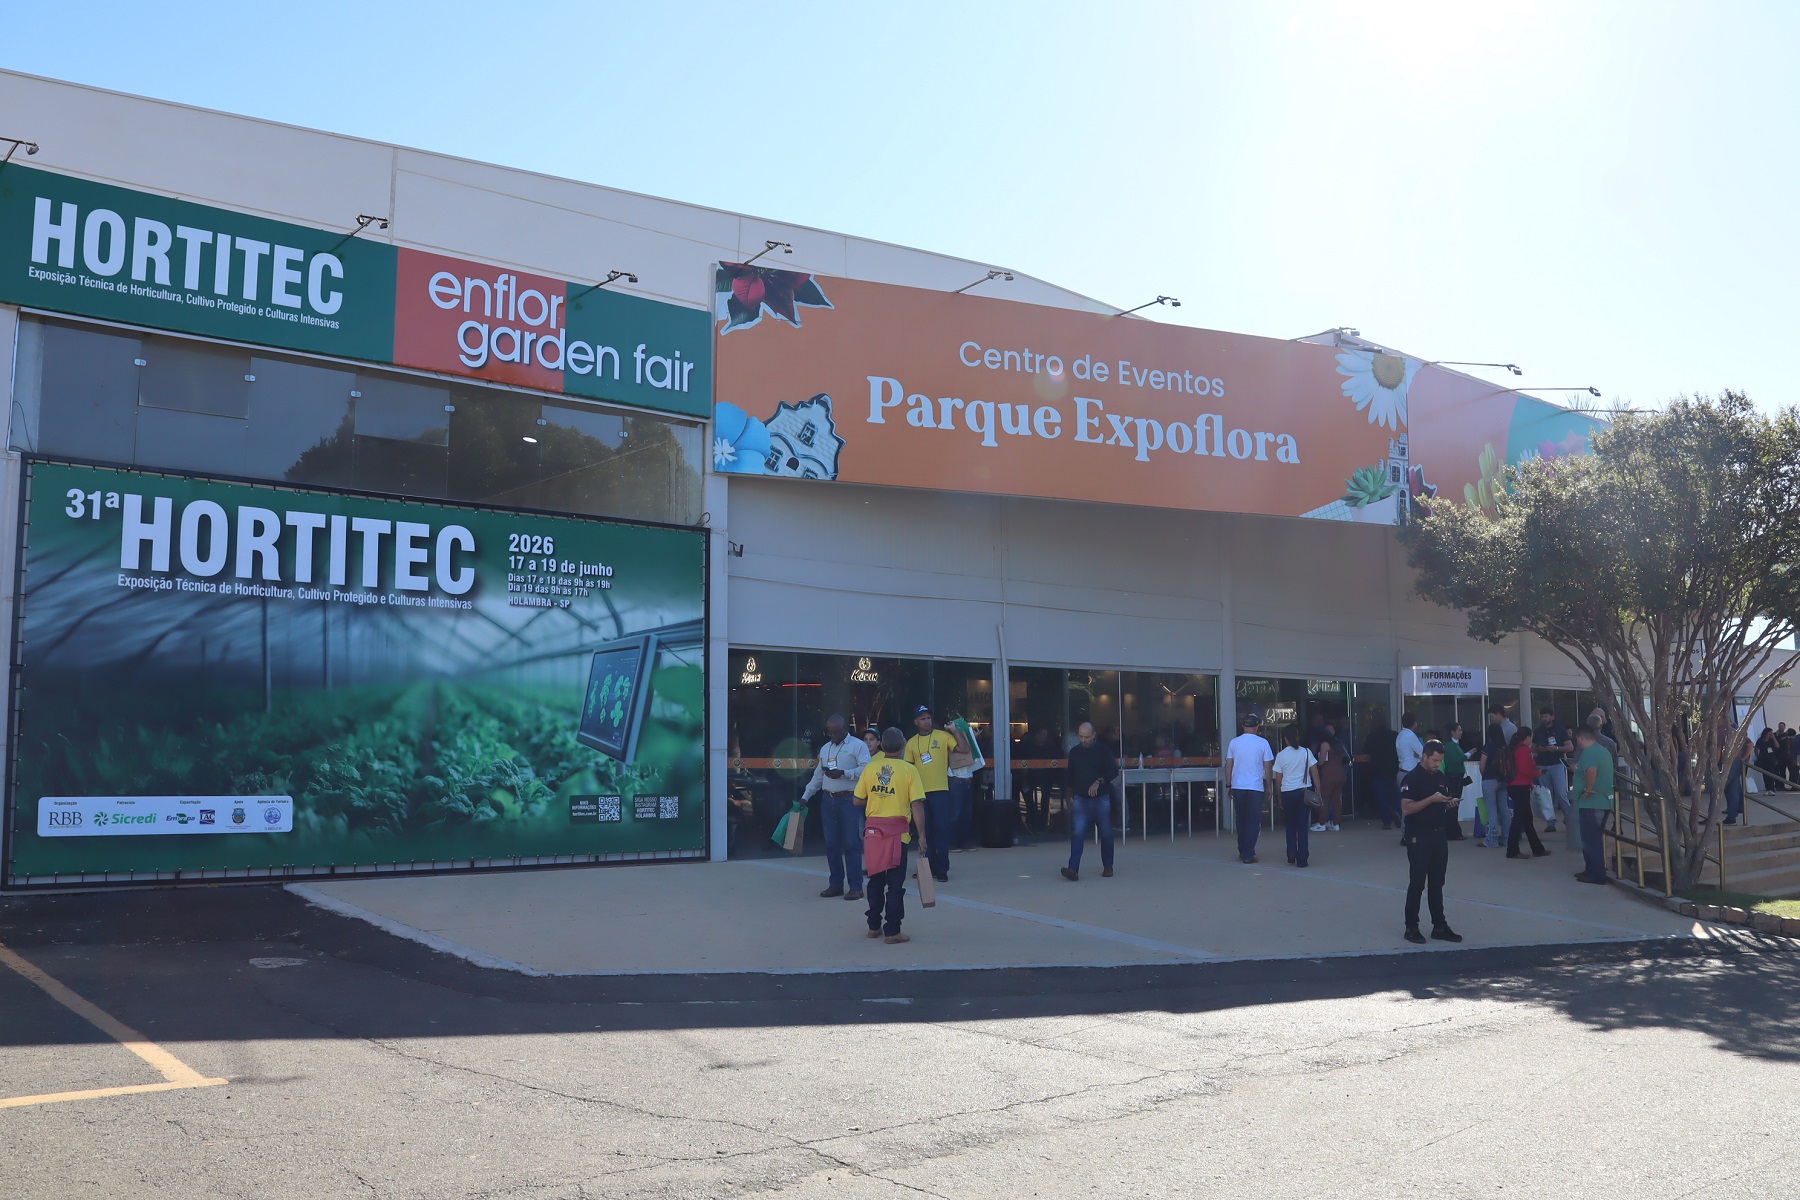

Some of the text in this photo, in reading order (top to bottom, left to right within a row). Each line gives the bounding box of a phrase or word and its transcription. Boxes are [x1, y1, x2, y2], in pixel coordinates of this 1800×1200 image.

[31, 196, 344, 315] HORTITEC
[28, 266, 340, 329] Exposição Técnica de Horticultura, Cultivo Protegido e Culturas Intensivas
[428, 271, 564, 329] enflor
[457, 320, 694, 393] garden fair
[959, 341, 1225, 397] Centro de Eventos
[866, 375, 1301, 464] Parque Expoflora
[120, 493, 476, 595] HORTITEC
[508, 533, 554, 555] 2026
[508, 556, 613, 577] 17 a 19 de junho
[117, 573, 472, 610] Exposição Técnica de Horticultura, Cultivo Protegido e Culturas Intensivas
[508, 573, 611, 589] Dias 17 e 18 das 9h às 19h
[508, 582, 589, 596] Dia 19 das 9h às 17h
[508, 596, 552, 607] HOLAMBRA
[559, 600, 571, 608] SP
[1421, 670, 1472, 681] INFORMAÇÕES
[1427, 681, 1469, 689] INFORMATION
[871, 785, 896, 795] AFFLA
[48, 811, 83, 826] RBB
[111, 812, 157, 824] Sicredi
